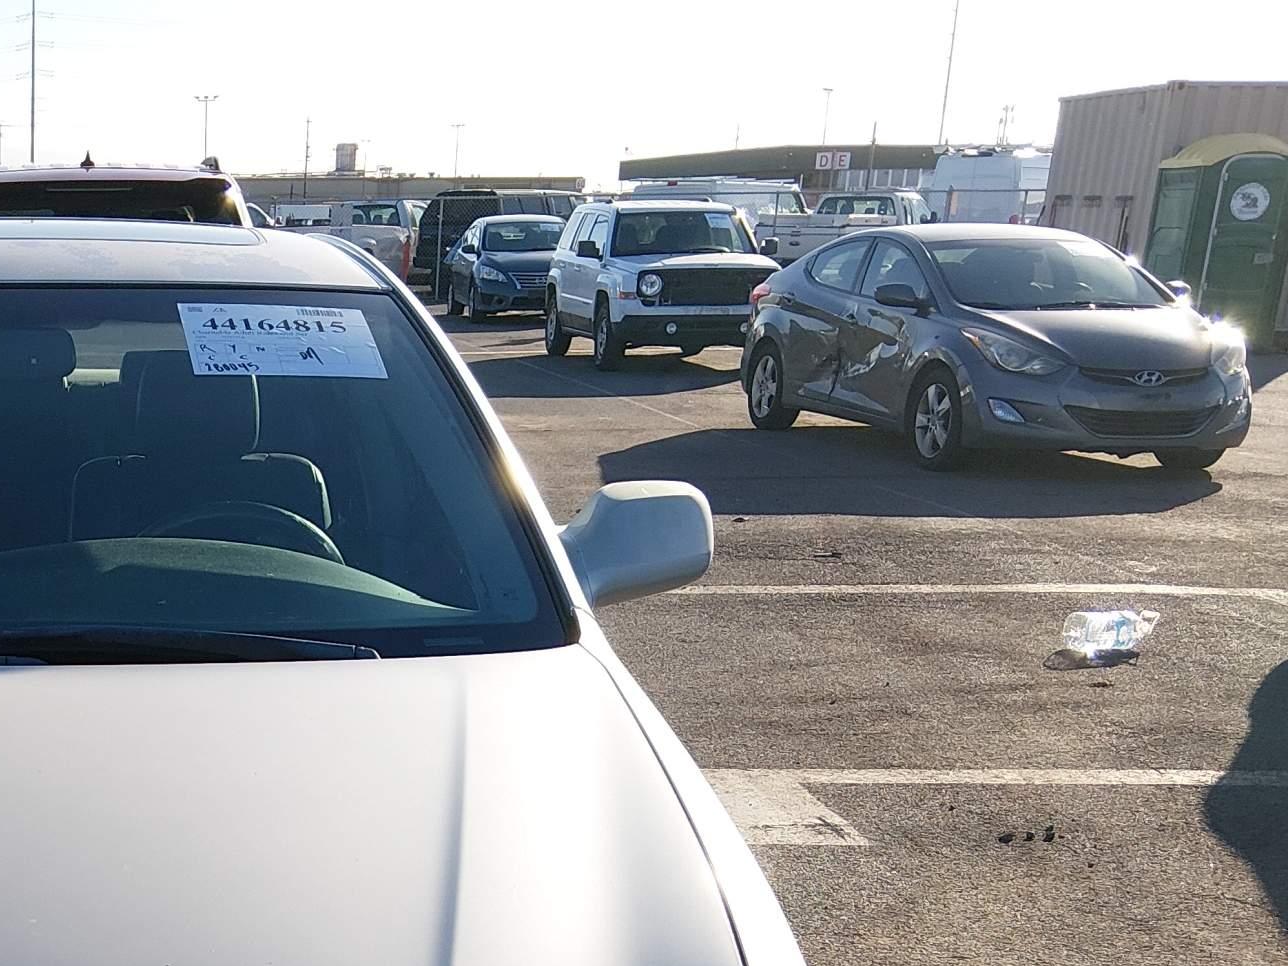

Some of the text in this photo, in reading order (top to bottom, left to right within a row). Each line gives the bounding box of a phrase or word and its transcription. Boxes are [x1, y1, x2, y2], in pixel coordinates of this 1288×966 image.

[820, 154, 848, 167] D E
[202, 317, 347, 334] 44164815
